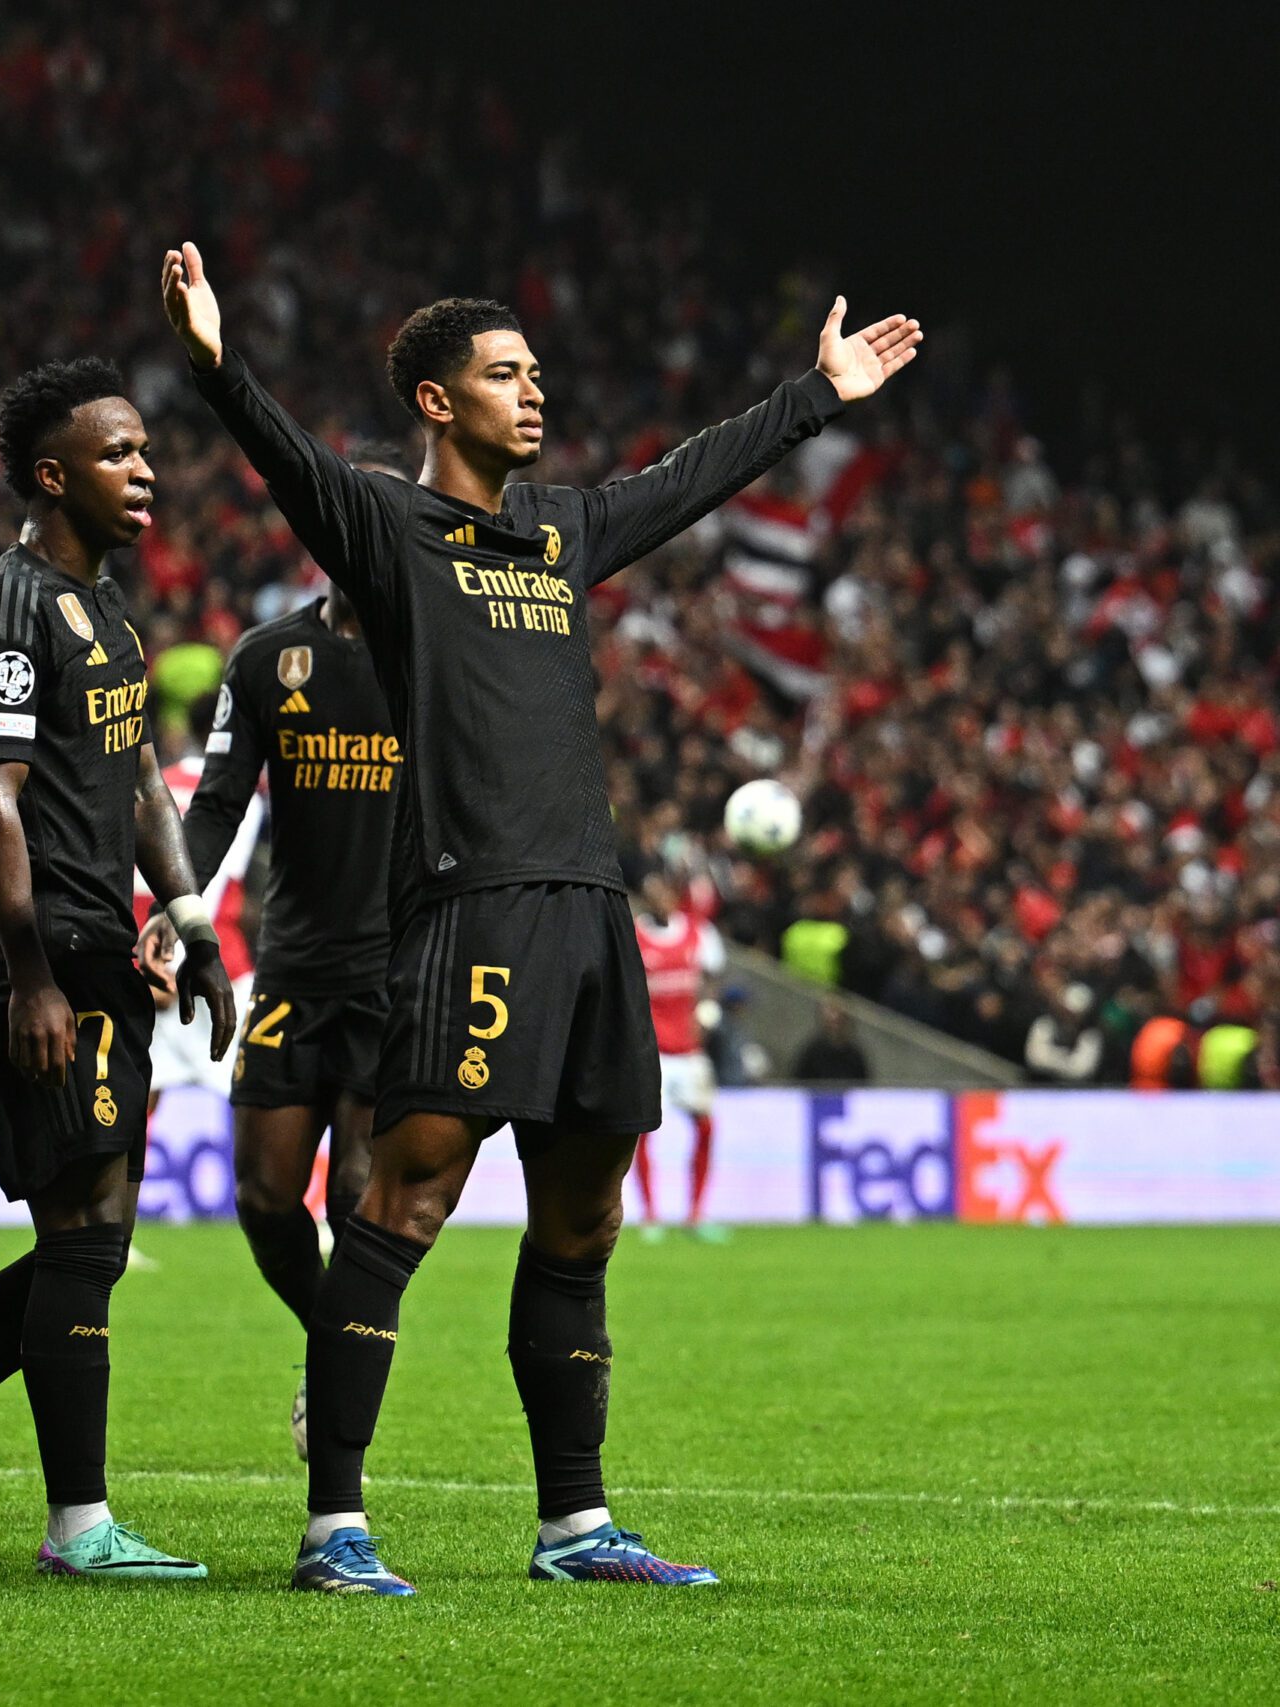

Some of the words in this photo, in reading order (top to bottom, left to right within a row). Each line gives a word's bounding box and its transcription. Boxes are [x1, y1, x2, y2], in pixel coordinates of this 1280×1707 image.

[452, 562, 573, 604] Emirates
[488, 601, 517, 629] FLY
[520, 603, 570, 636] BETTER
[278, 727, 404, 763] Emirate
[294, 764, 322, 790] FLY
[327, 764, 394, 792] BETTER
[468, 965, 510, 1040] 5
[77, 1010, 114, 1080] 7
[811, 1088, 1065, 1222] FedEx
